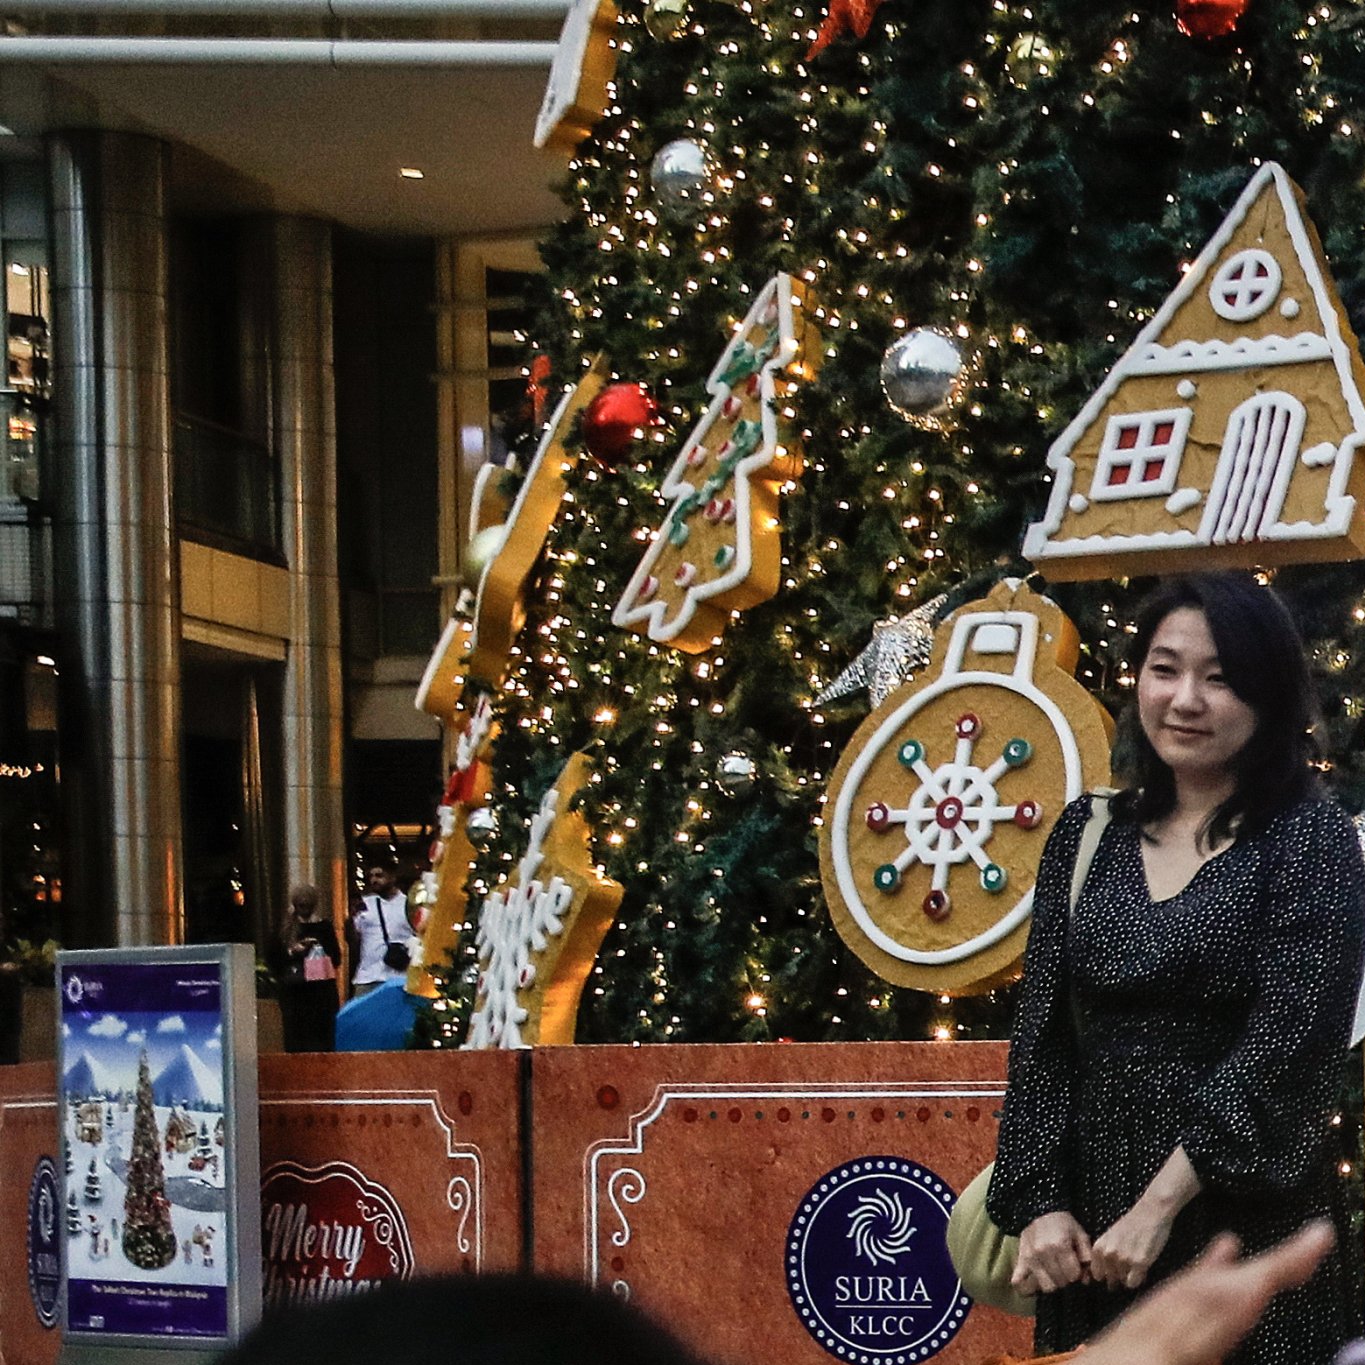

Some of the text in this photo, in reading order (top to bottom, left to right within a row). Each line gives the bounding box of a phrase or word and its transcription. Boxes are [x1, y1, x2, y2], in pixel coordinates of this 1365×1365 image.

[266, 1203, 366, 1277] Merry
[835, 1276, 932, 1302] SURIA
[849, 1315, 914, 1336] KLCC
